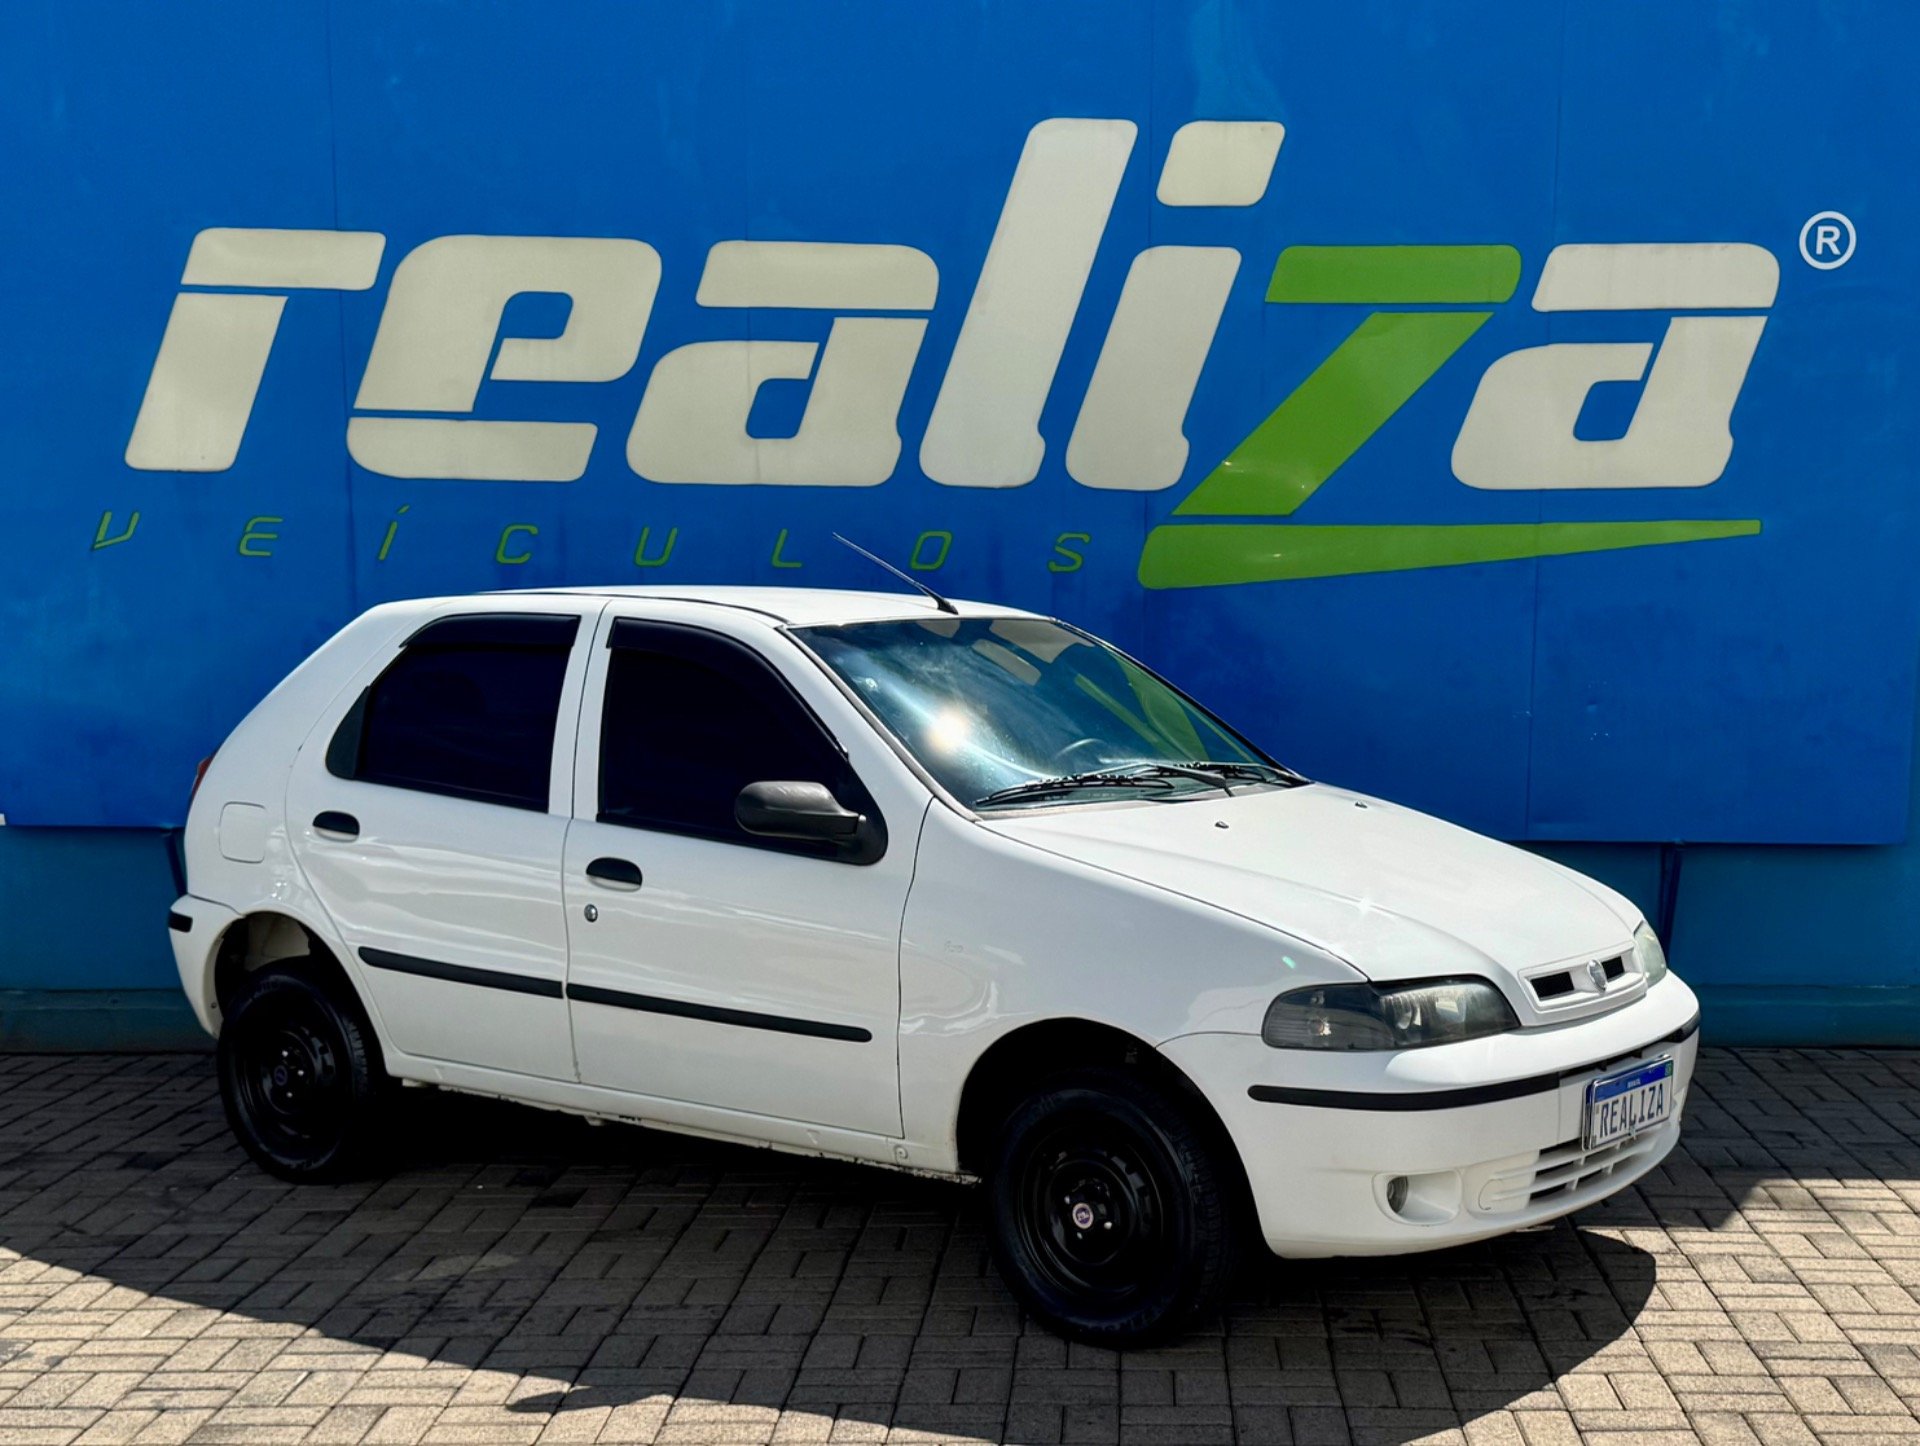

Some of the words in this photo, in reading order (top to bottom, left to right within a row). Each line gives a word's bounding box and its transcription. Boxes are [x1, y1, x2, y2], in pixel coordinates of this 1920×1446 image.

[125, 117, 1780, 588] realiza
[92, 505, 1091, 574] VEÍCULOS
[1600, 1083, 1664, 1137] REALIZA
